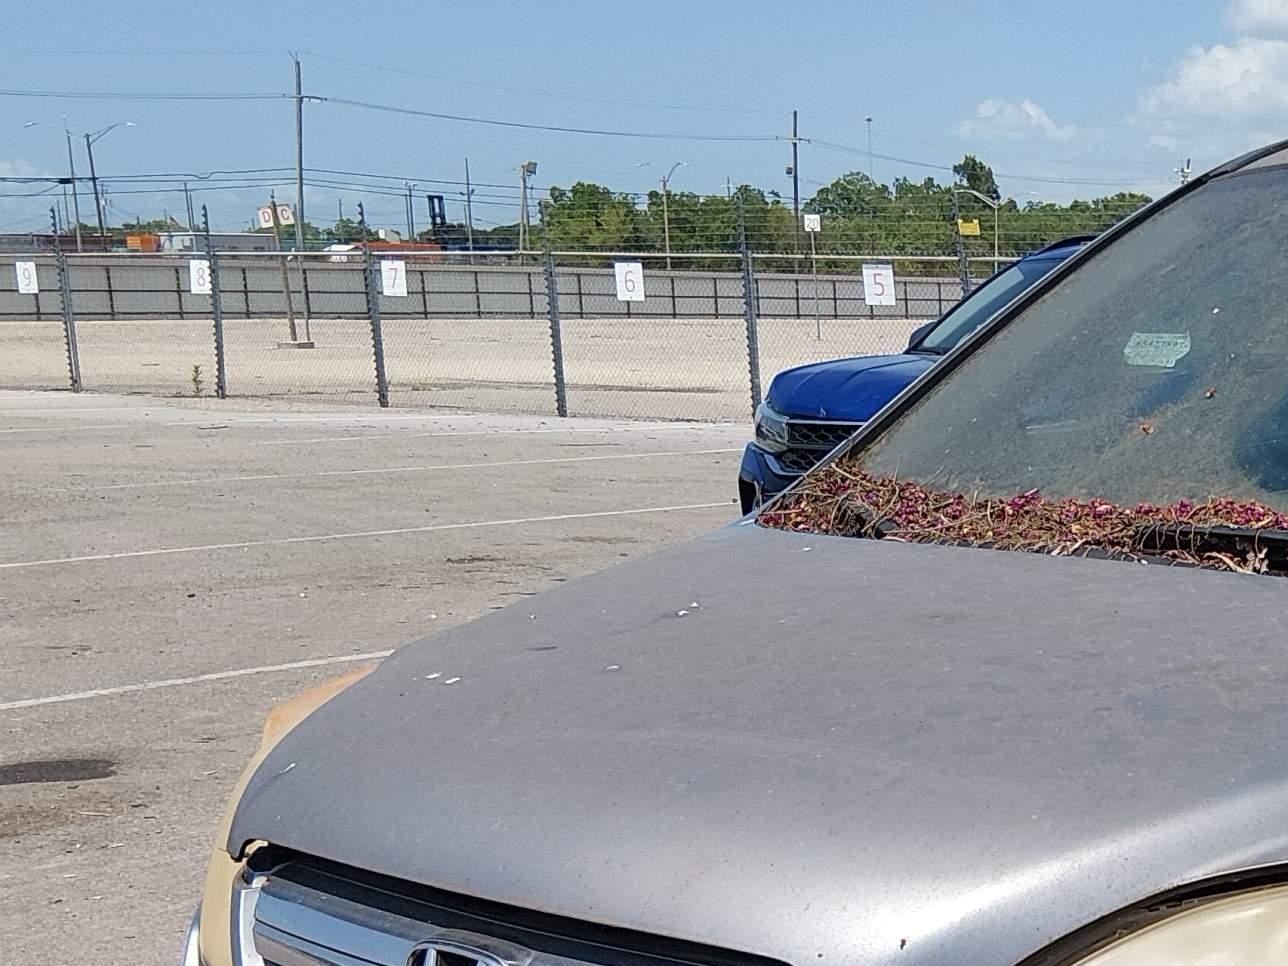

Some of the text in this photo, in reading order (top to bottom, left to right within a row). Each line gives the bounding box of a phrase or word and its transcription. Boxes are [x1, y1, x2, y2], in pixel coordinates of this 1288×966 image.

[262, 210, 271, 223] D
[280, 208, 290, 221] C
[23, 268, 31, 287] 9
[196, 266, 206, 287] 8
[388, 267, 398, 289] 7
[624, 270, 636, 293] 6
[873, 273, 885, 297] 5
